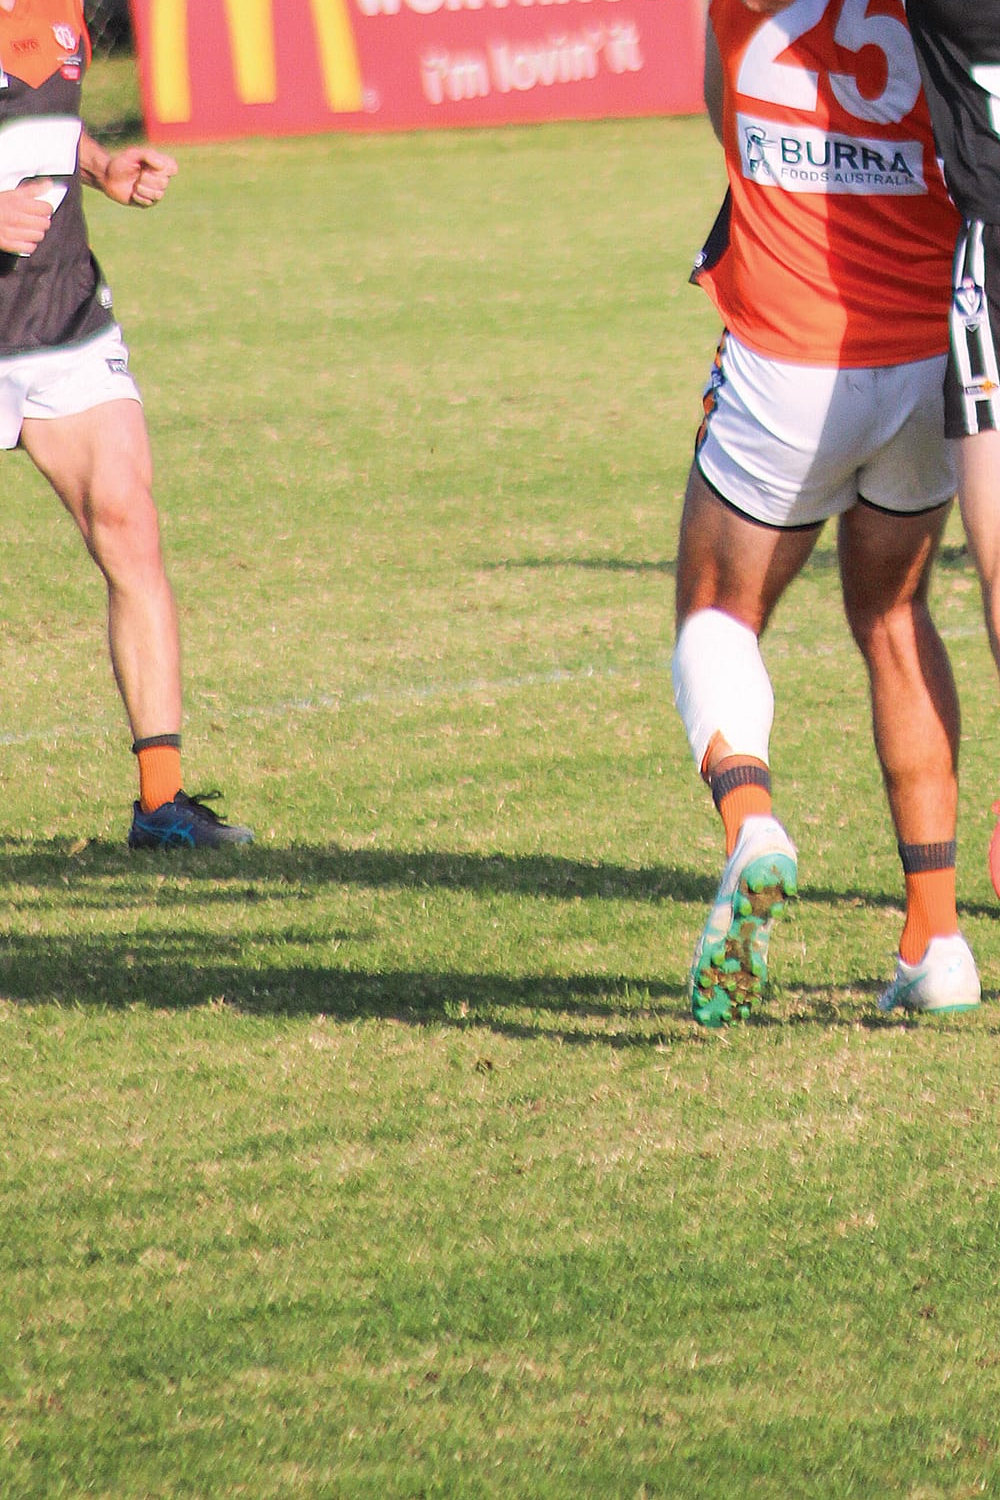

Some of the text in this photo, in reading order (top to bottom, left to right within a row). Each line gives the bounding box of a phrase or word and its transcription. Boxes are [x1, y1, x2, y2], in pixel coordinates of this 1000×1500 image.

[604, 22, 644, 74] it
[780, 137, 915, 178] BURRA
[780, 167, 830, 182] FOODS
